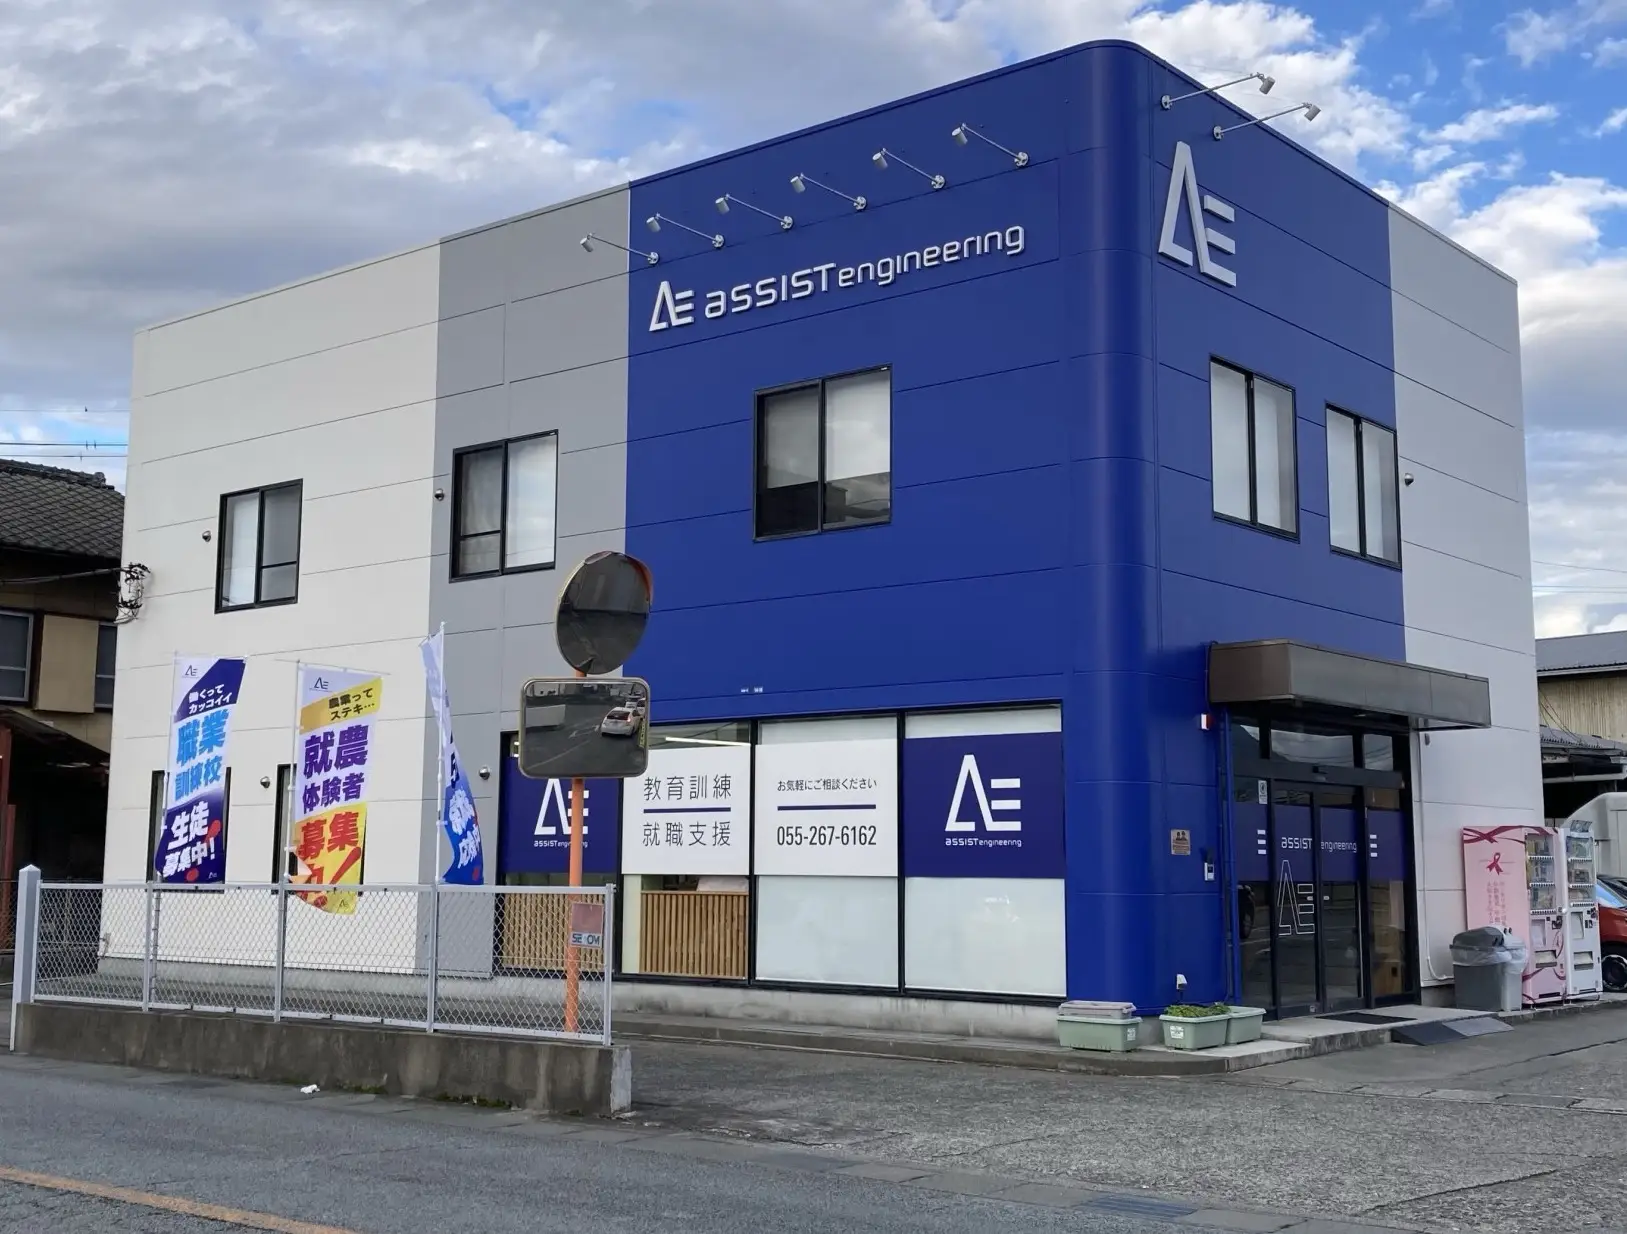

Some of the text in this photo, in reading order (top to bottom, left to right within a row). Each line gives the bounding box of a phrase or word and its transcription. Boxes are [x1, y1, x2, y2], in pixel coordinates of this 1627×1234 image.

[188, 692, 233, 714] カッコイイ
[303, 724, 369, 779] 就農
[302, 772, 365, 815] 体験者
[643, 773, 731, 801] 教育訓練
[777, 778, 877, 792] お気軽にご相談ください
[167, 800, 210, 851] 生徒
[296, 811, 360, 861] 募集
[642, 821, 731, 847] 就職支援
[777, 825, 877, 846] 055-267-6162
[1320, 841, 1357, 853] engineering
[571, 933, 600, 946] SEOM
